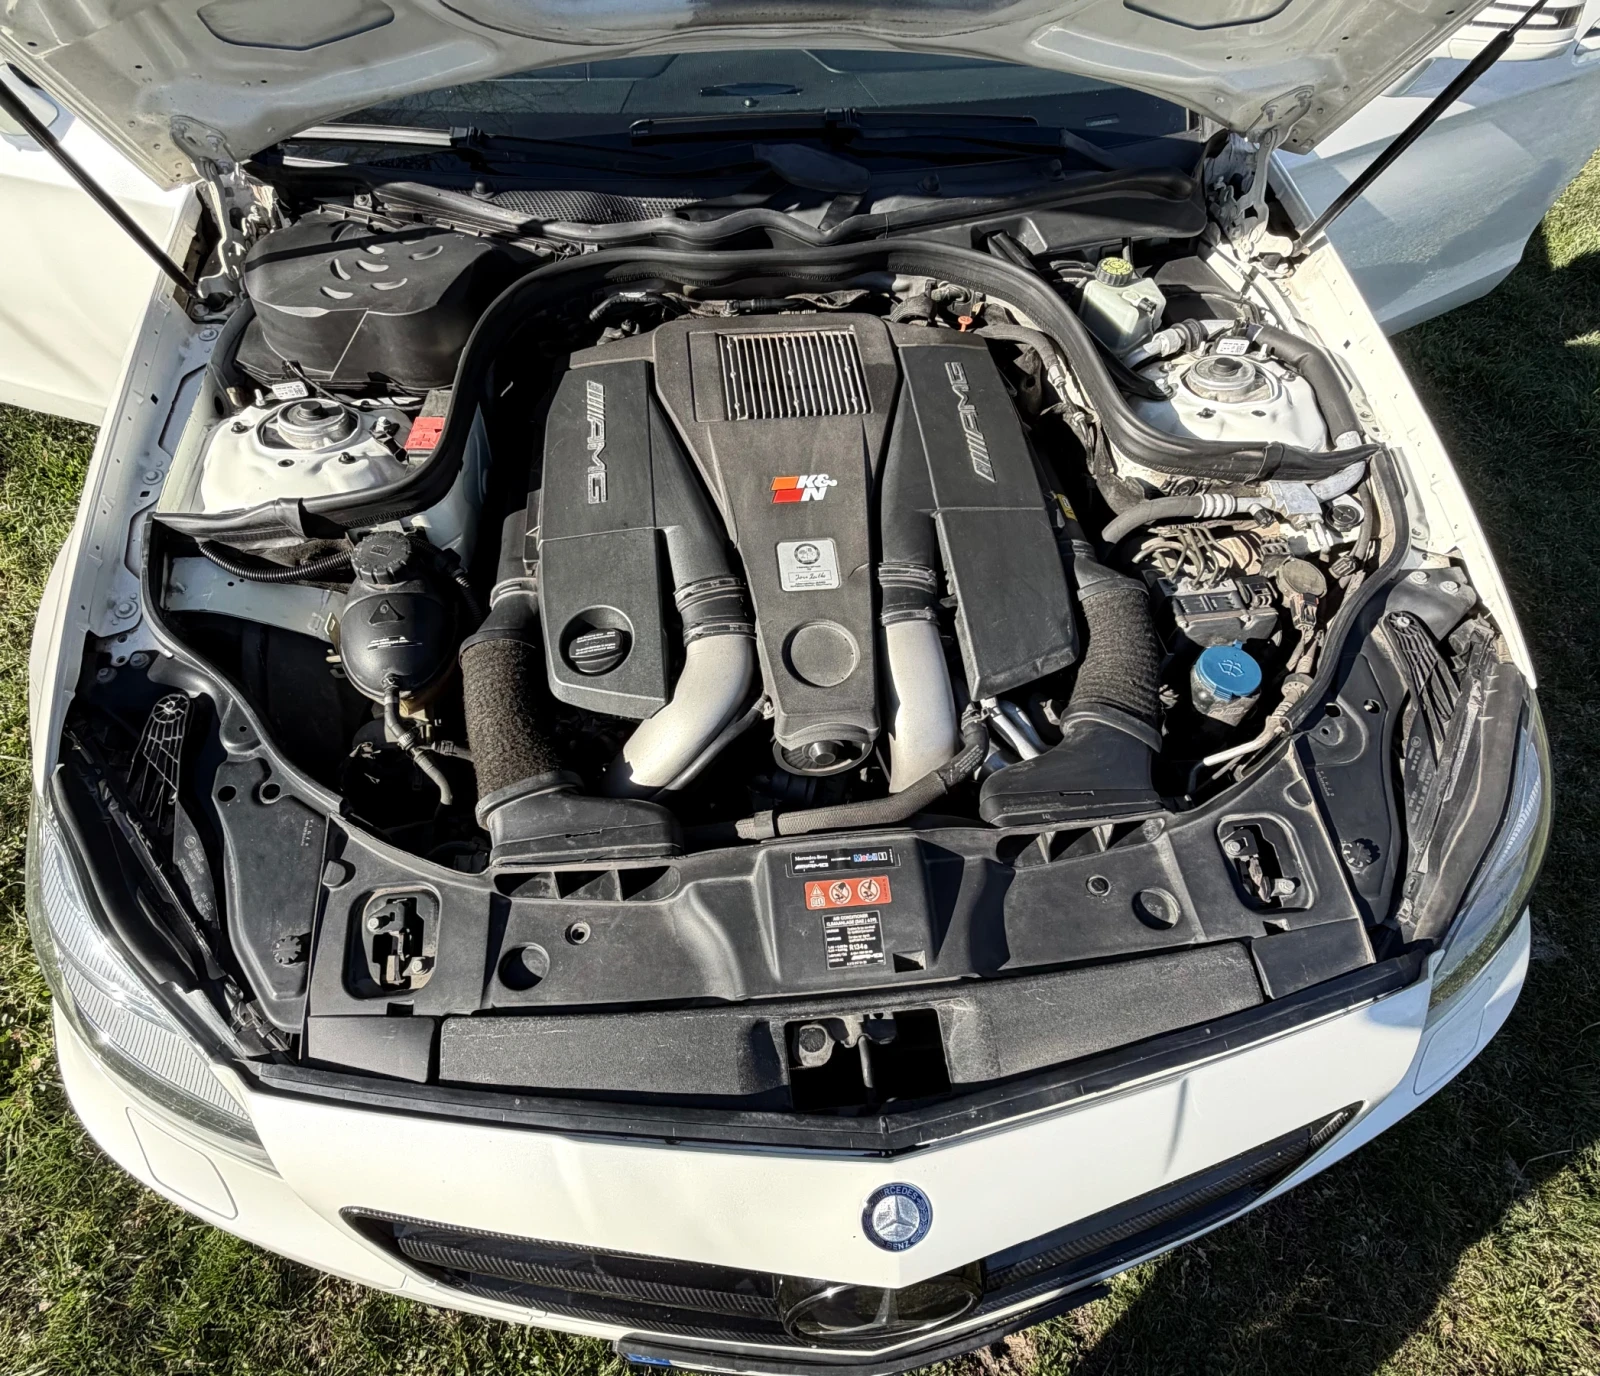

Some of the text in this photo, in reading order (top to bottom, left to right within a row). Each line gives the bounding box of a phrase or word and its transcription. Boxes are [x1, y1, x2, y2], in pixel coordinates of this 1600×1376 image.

[586, 405, 607, 504] AMG
[853, 853, 878, 863] Mobil
[875, 1186, 918, 1201] ERCEDES
